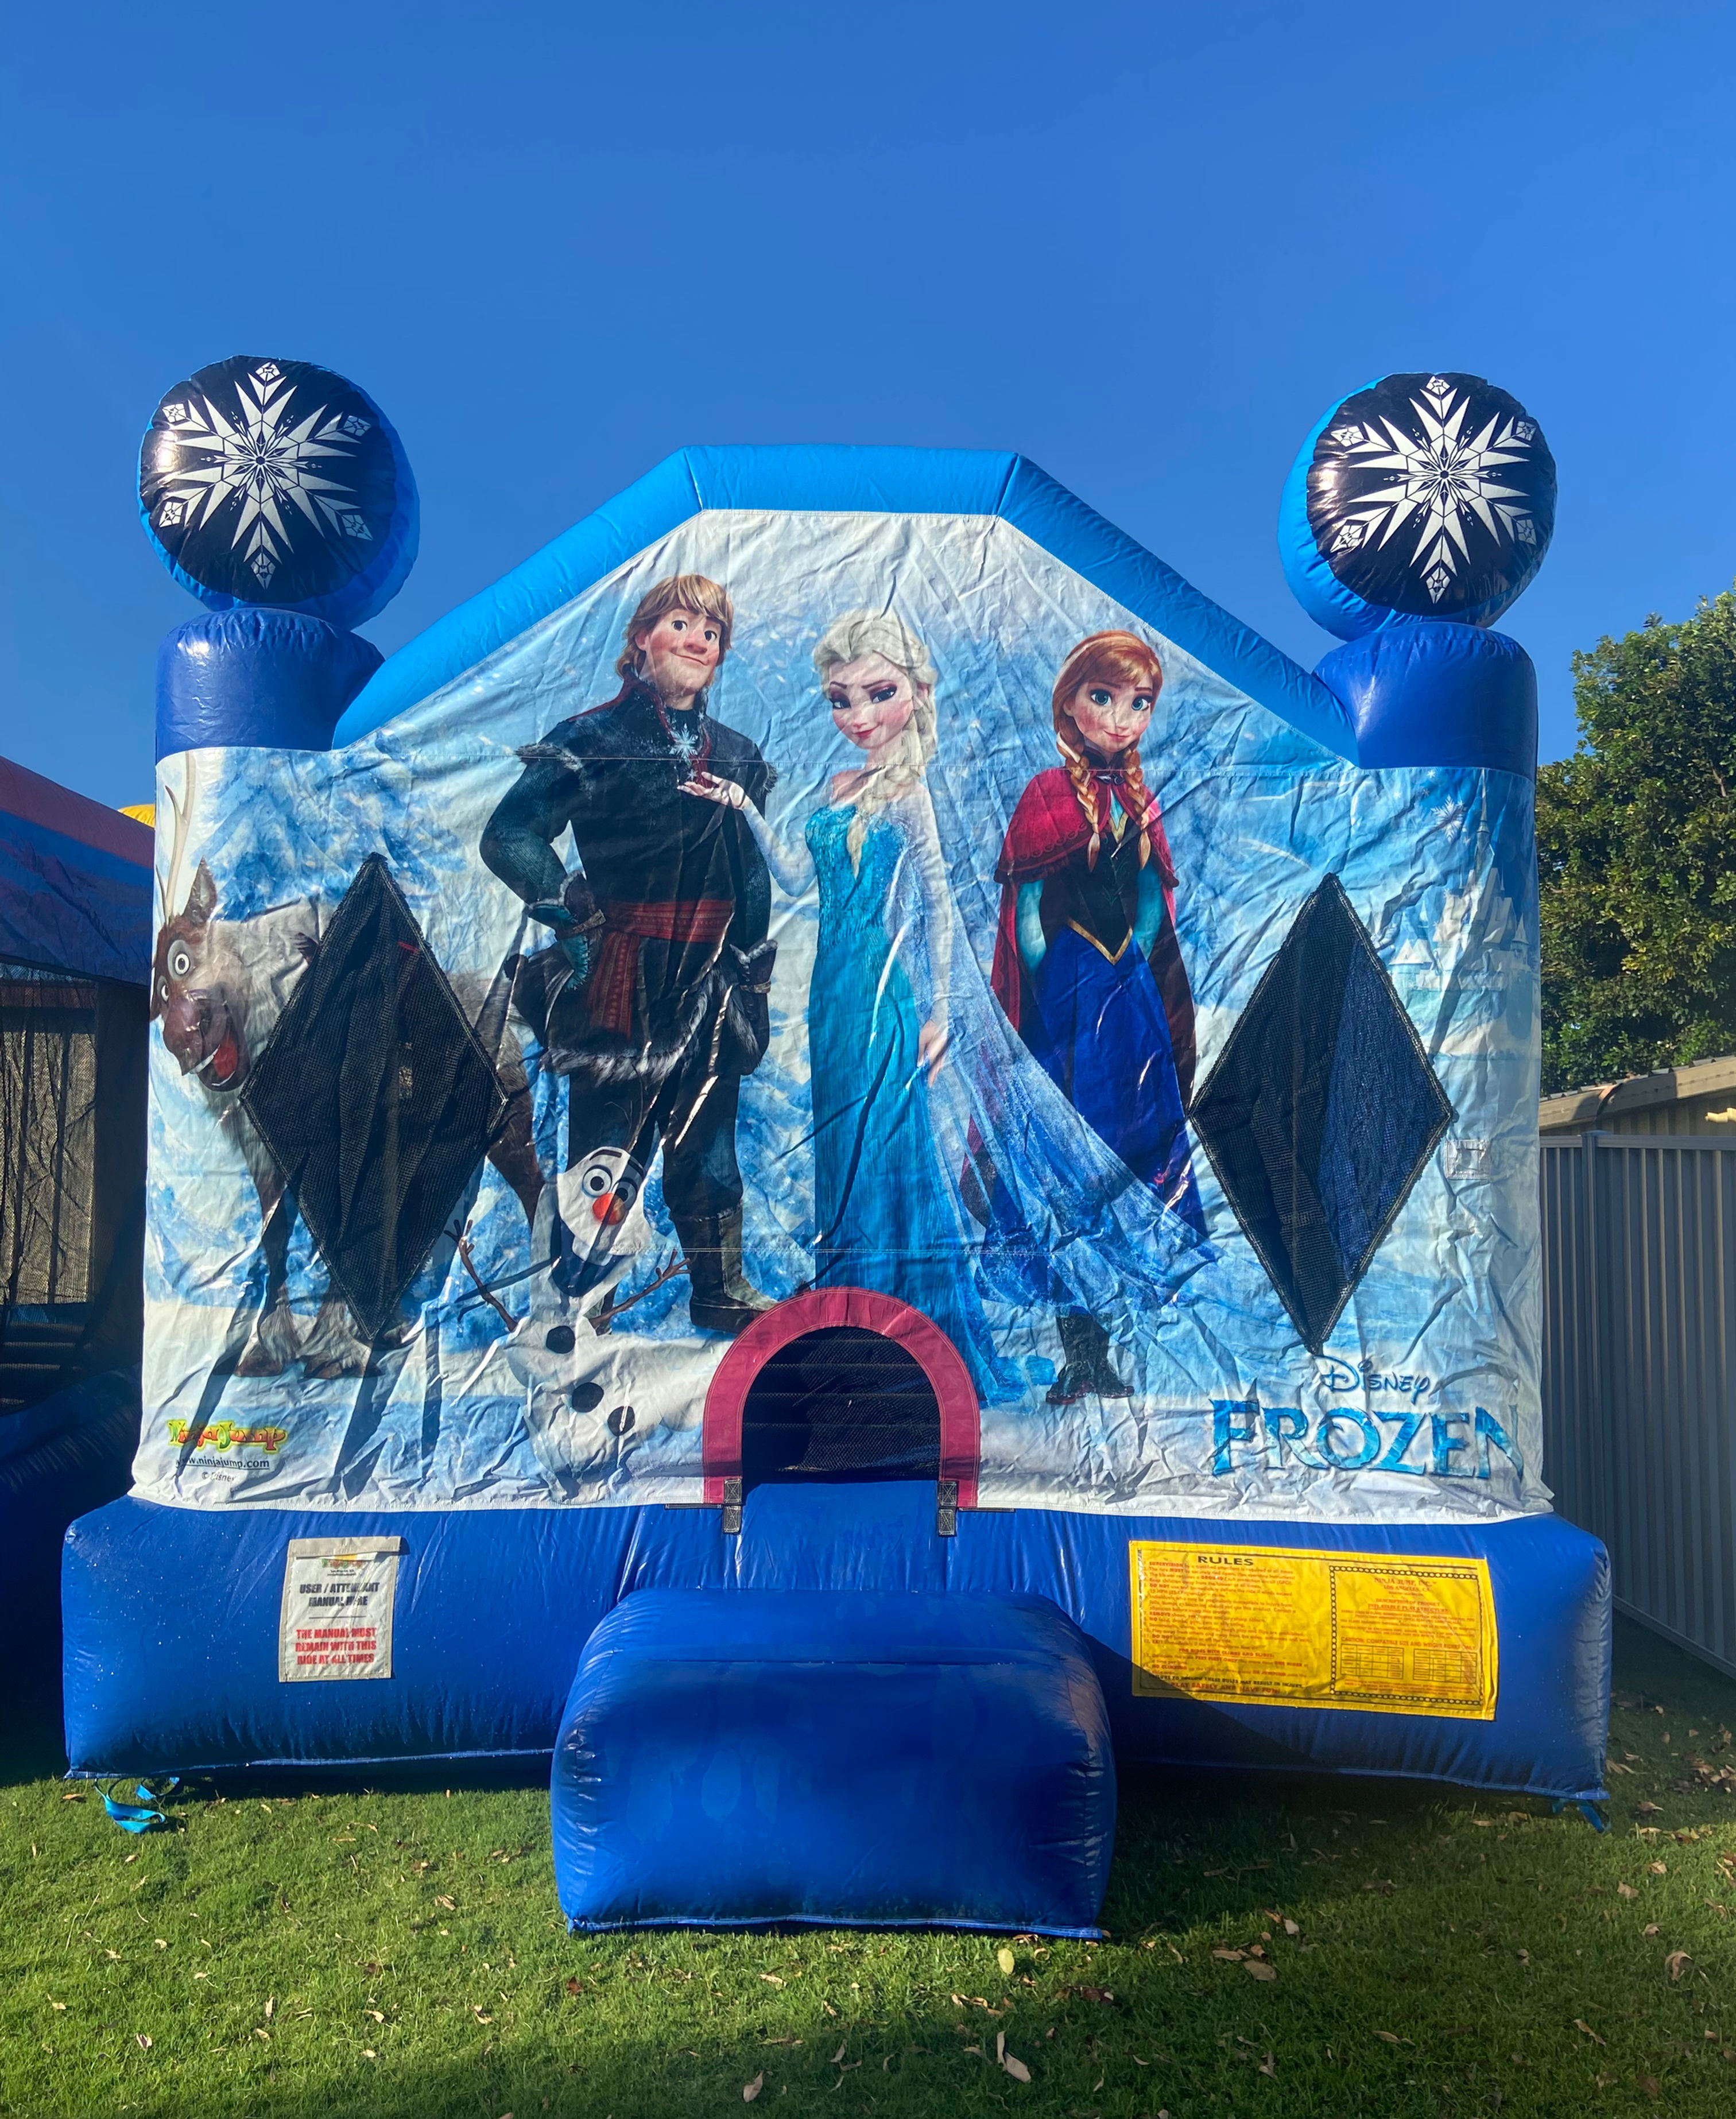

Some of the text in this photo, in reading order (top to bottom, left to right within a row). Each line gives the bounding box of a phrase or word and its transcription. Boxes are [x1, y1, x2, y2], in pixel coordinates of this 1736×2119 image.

[1208, 1399, 1524, 1482] FROZEN
[1198, 1555, 1253, 1566] RULES
[299, 1583, 322, 1594] USER
[308, 1596, 344, 1606] MANUAL
[296, 1627, 377, 1639] THE MANUAL MUST
[295, 1640, 377, 1652] REMAIN WITH THIS
[297, 1653, 375, 1665] RIDE AT ALL TIMES
